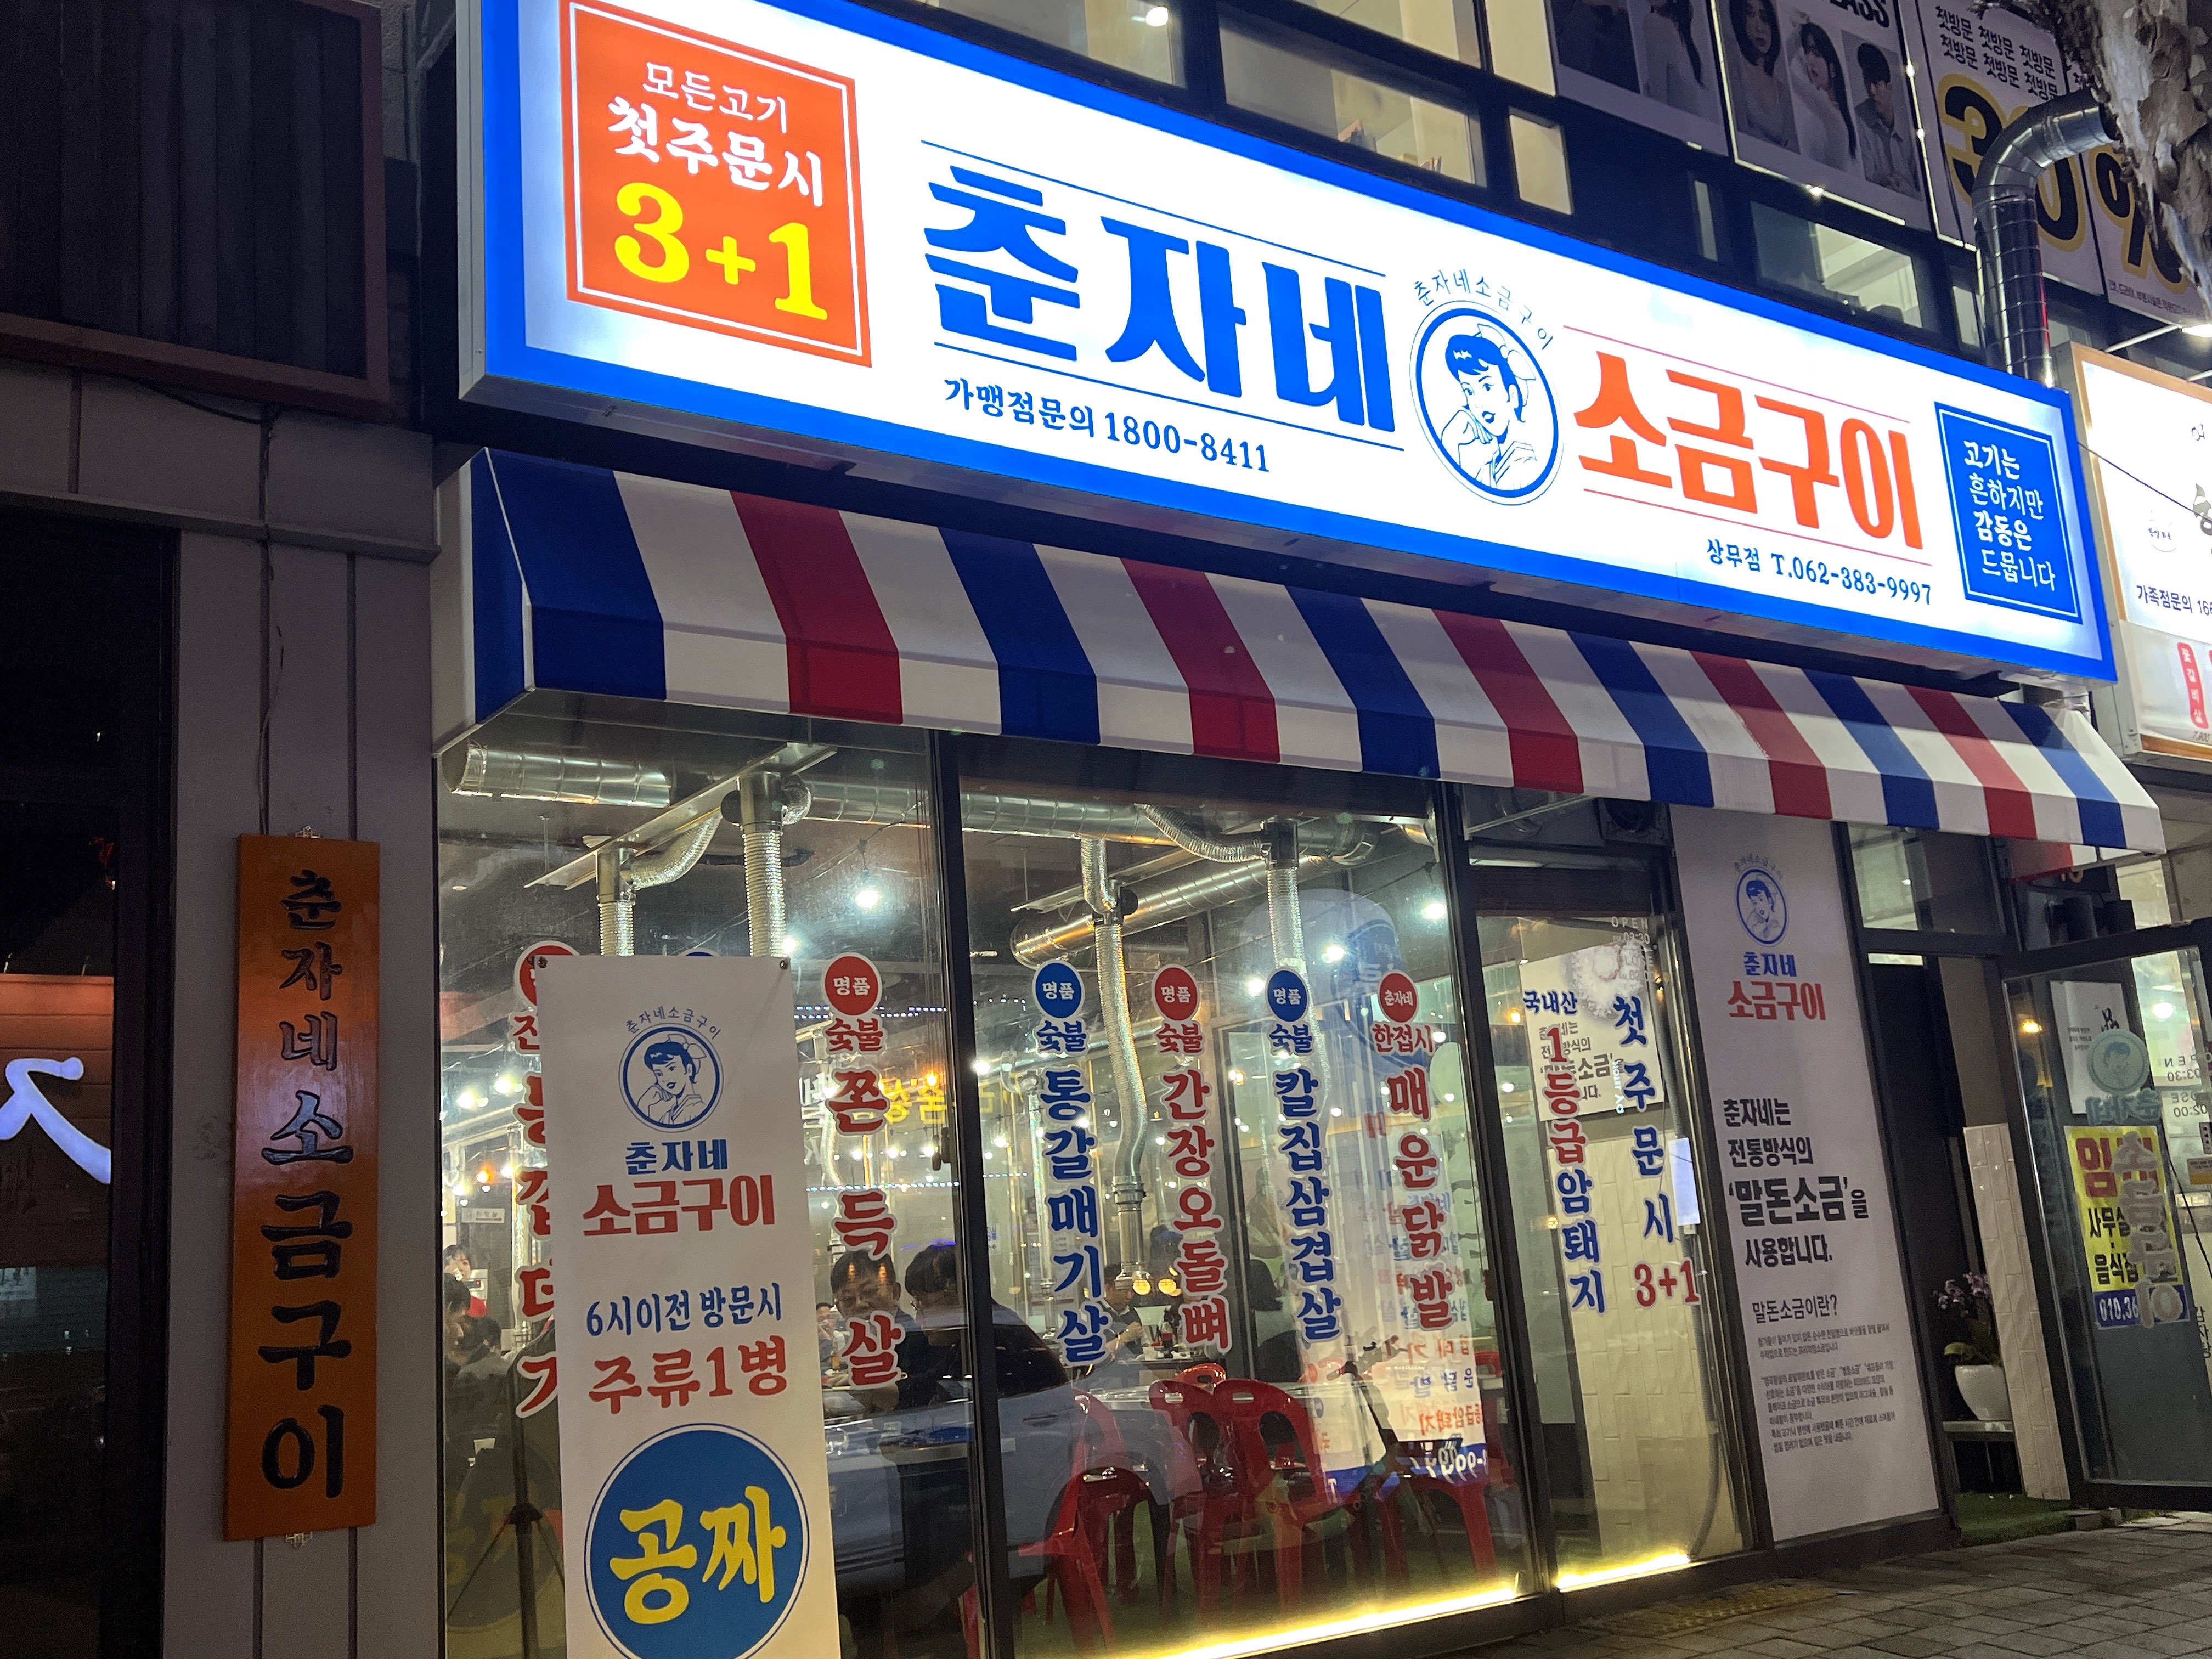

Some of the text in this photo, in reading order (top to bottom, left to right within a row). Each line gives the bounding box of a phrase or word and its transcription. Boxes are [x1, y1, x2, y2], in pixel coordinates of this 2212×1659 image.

[1935, 5, 2056, 79] 첫방문 첫방문 첫방문
[1940, 34, 1978, 70] 첫방문
[1984, 53, 2020, 88] 첫방문
[614, 182, 828, 320] 3+1
[924, 165, 1395, 432] 춘자네
[1414, 268, 1554, 351] 춘자네소금구이
[944, 378, 1269, 473] 가맹점문의 1800-8411
[1573, 351, 1923, 550] 소금구이
[1963, 441, 2020, 480] 고기는
[1968, 472, 2044, 520] 흔하지만
[1973, 510, 2032, 551] 감동은
[1707, 539, 1933, 605] 상무점 T.062-383-9997
[1982, 549, 2056, 591] 드뭅니다
[2136, 584, 2193, 614] 가족점문의
[1743, 951, 1797, 977] 춘자네
[832, 975, 871, 996] 명품
[1042, 981, 1075, 1001] 명품
[1161, 985, 1192, 1003] 명품
[1273, 987, 1301, 1006] 명품
[1384, 989, 1414, 1007] 춘자네
[1523, 990, 1578, 1015] 국내산
[1728, 980, 1826, 1021] 소금구이
[626, 1006, 721, 1040] 춘자네소금구이
[825, 1018, 884, 1053] 숯불
[1036, 1020, 1087, 1054] 숯불
[1156, 1023, 1203, 1053] 숯불
[1269, 1024, 1313, 1054] 숯불
[1372, 1024, 1434, 1053] 한접시
[1723, 1098, 1791, 1127] 춘자네는
[625, 1138, 729, 1175] 춘자네
[1728, 1136, 1814, 1167] 전통방식의
[258, 868, 354, 1499] 춘자네소금구이
[1387, 1067, 1453, 1329] 매운닭발
[583, 1174, 775, 1236] 소금구이
[1040, 1070, 1108, 1363] 통갈매기살
[1163, 1069, 1229, 1350] 간장오돌뼈
[1276, 1069, 1341, 1341] 칼집삼겹살
[1745, 1234, 1833, 1268] 사용합니다.
[1634, 1260, 1700, 1307] 3+1
[586, 1282, 783, 1336] 6시이전 방문시
[1752, 1294, 1837, 1324] 말돈소금이란?
[588, 1335, 788, 1415] 주류1병
[609, 1485, 787, 1625] 공짜
